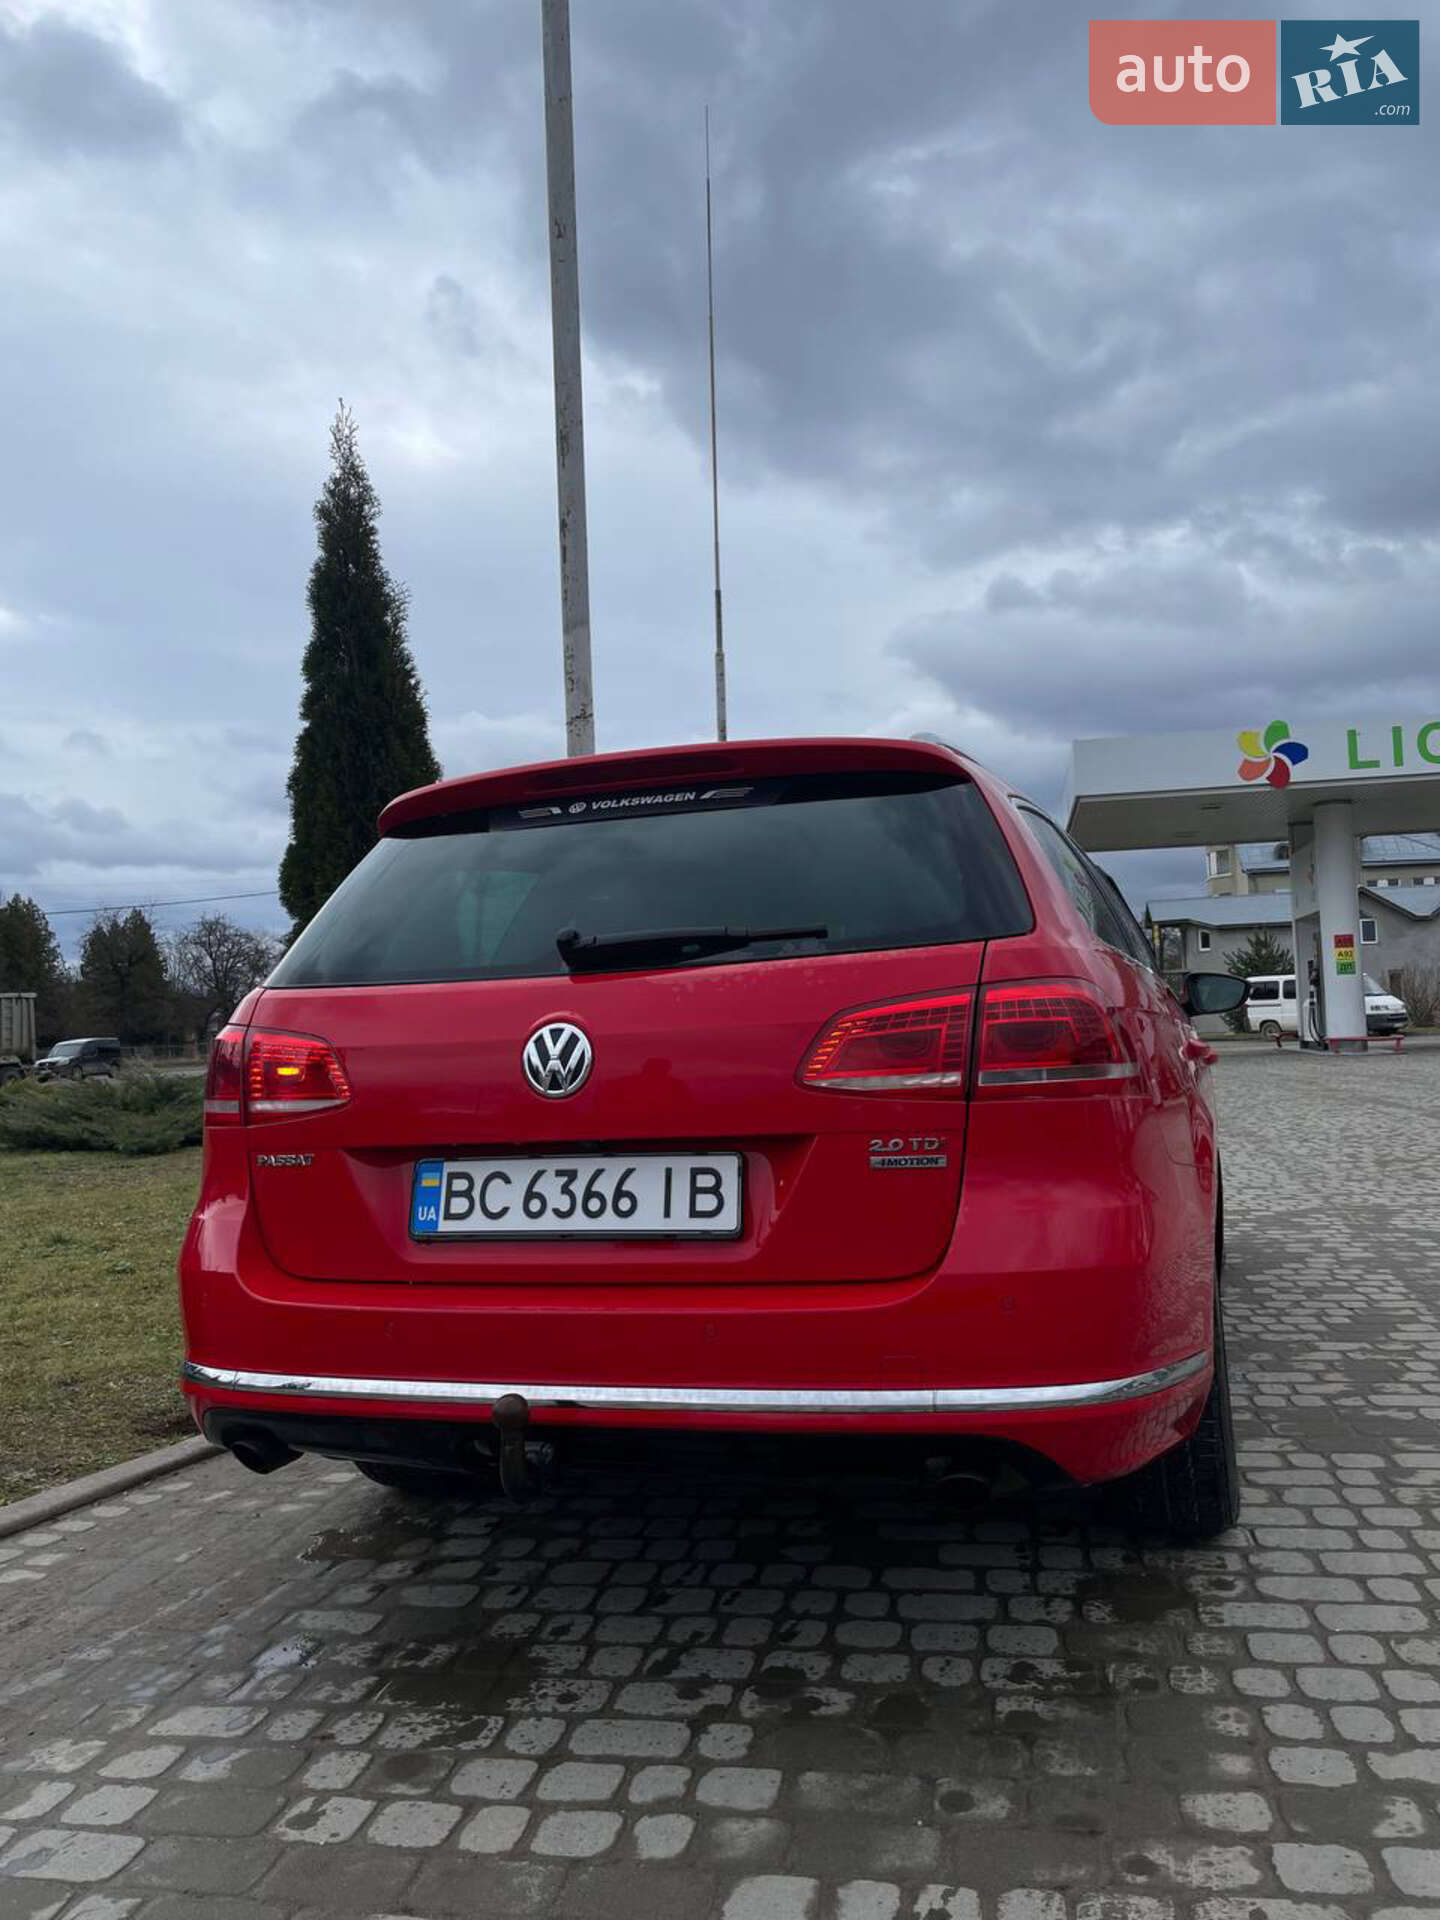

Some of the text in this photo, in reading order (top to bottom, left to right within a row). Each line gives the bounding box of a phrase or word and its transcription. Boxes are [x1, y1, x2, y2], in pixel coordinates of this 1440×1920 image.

[591, 791, 696, 810] VOLKSWAGEN
[443, 1167, 725, 1221] BC 6366 IB
[418, 1206, 437, 1221] UA
